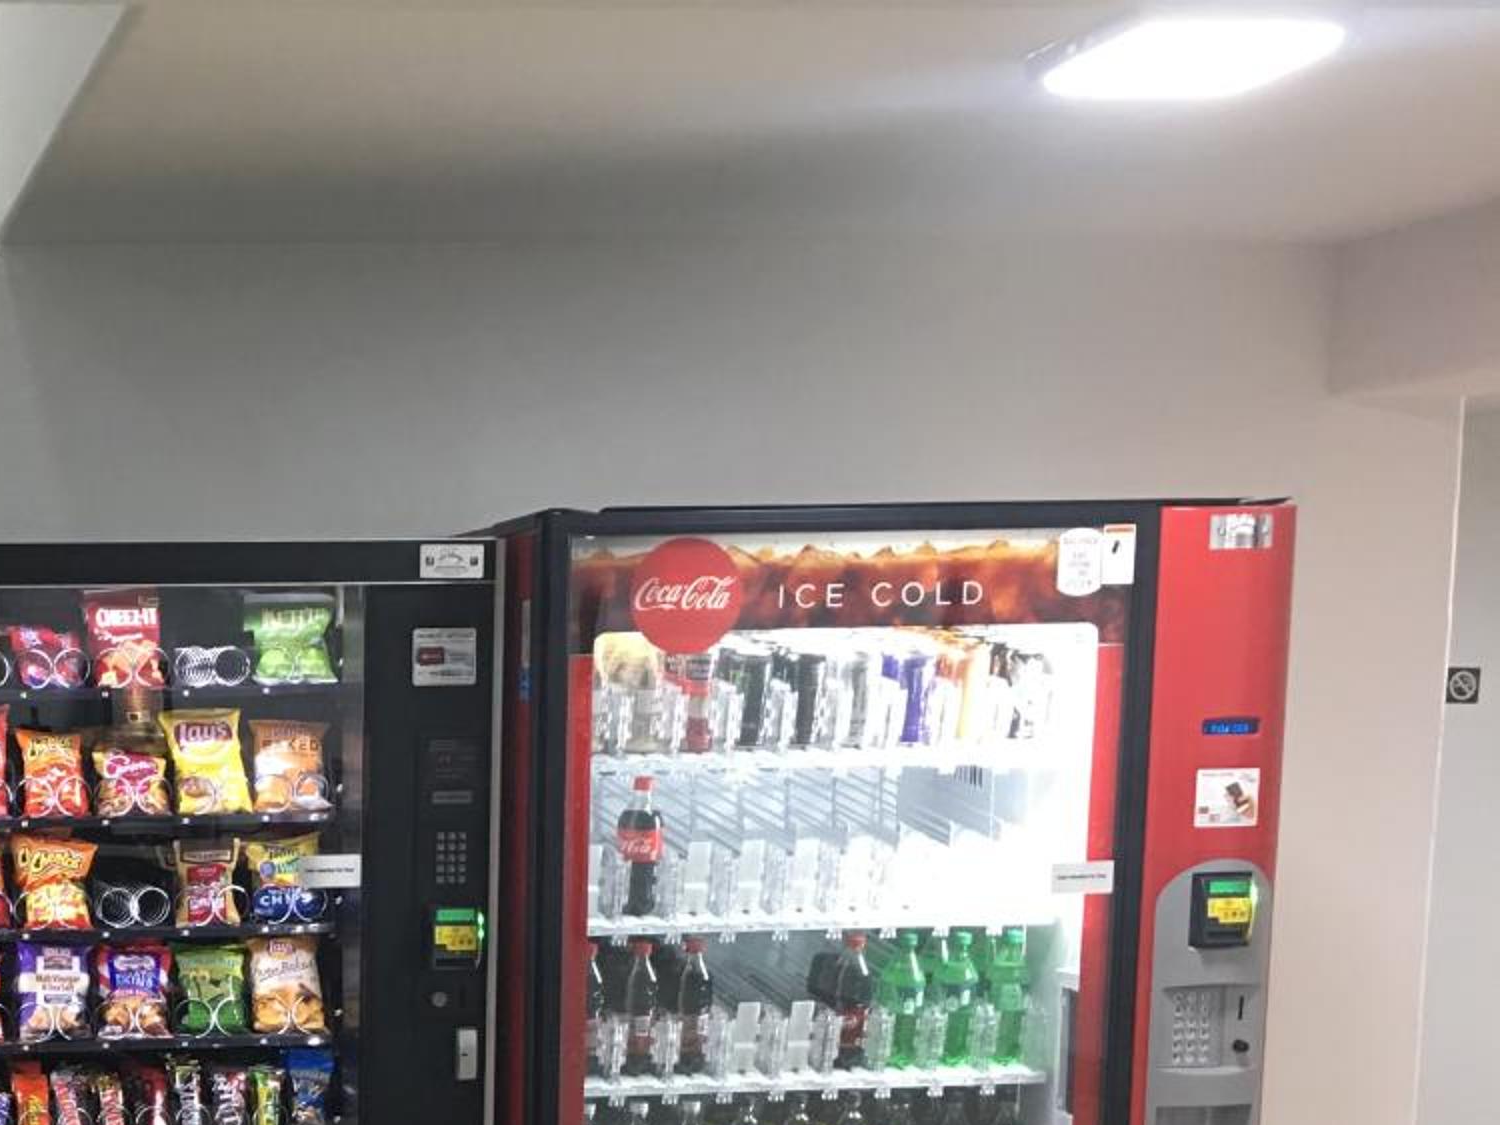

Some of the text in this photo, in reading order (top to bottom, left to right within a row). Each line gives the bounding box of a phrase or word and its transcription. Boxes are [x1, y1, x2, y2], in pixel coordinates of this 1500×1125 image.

[635, 575, 735, 610] Coca-Cola
[778, 580, 984, 609] ICE COLD
